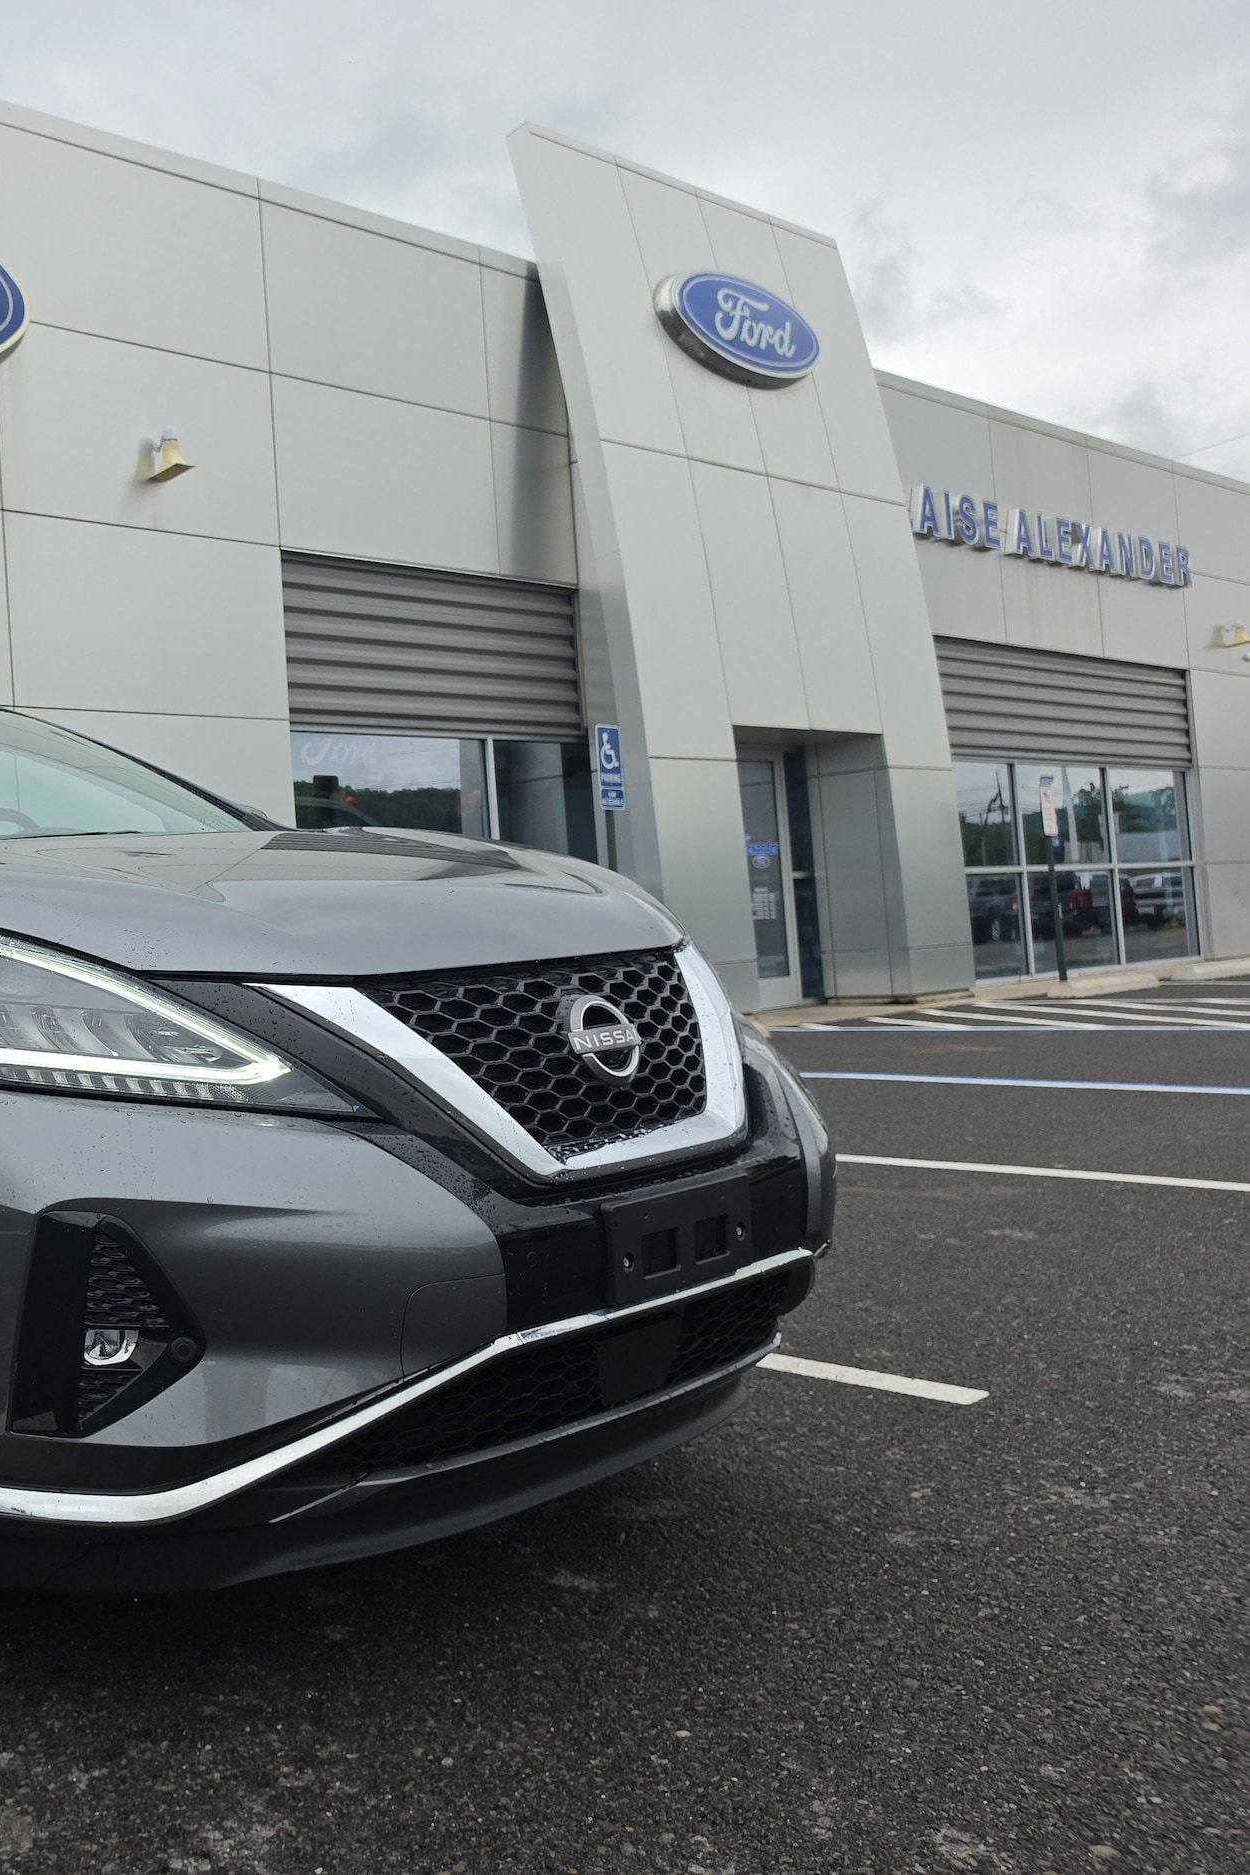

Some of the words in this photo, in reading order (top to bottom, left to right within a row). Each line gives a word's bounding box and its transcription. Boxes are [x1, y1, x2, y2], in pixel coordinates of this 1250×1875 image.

[714, 287, 797, 359] Ford
[910, 485, 1000, 549] AISE
[1012, 507, 1193, 588] ALEXANDER
[572, 1028, 636, 1051] NISSA
